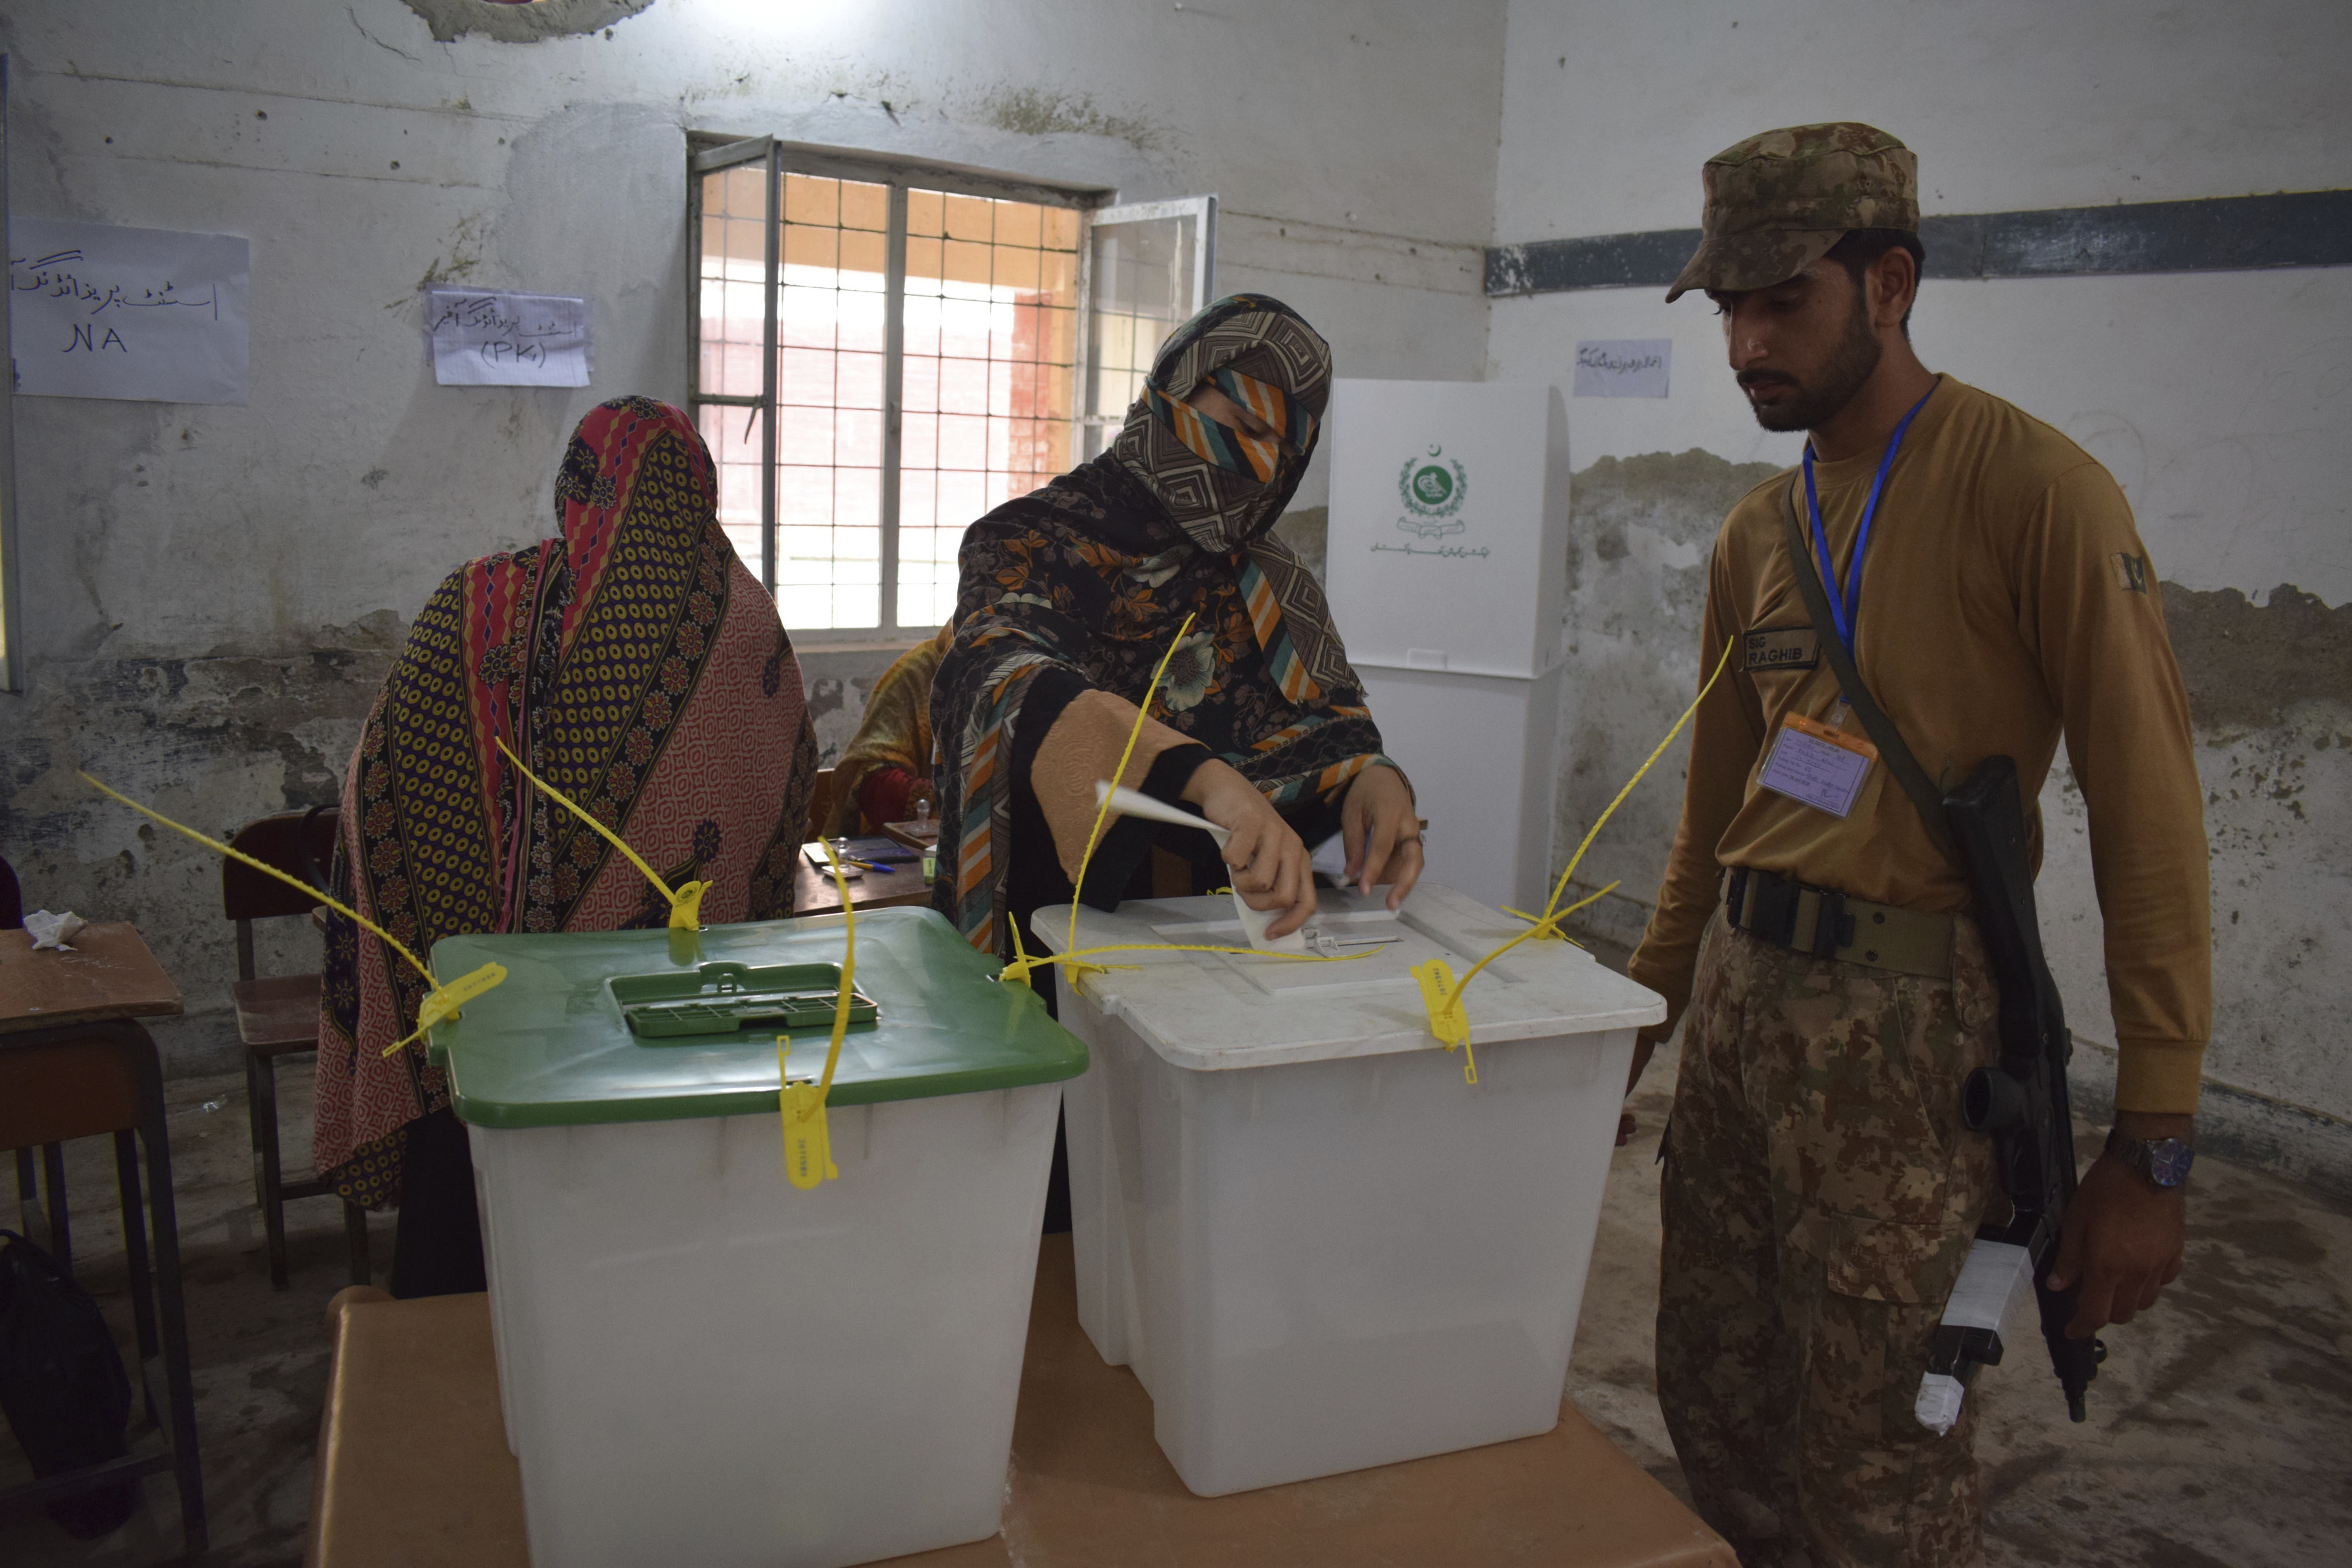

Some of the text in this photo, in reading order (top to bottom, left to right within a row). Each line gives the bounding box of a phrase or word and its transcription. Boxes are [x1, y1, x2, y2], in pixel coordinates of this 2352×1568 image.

[62, 324, 127, 352] NA
[1749, 636, 1766, 649] SIG
[1749, 647, 1802, 665] RAGHIB
